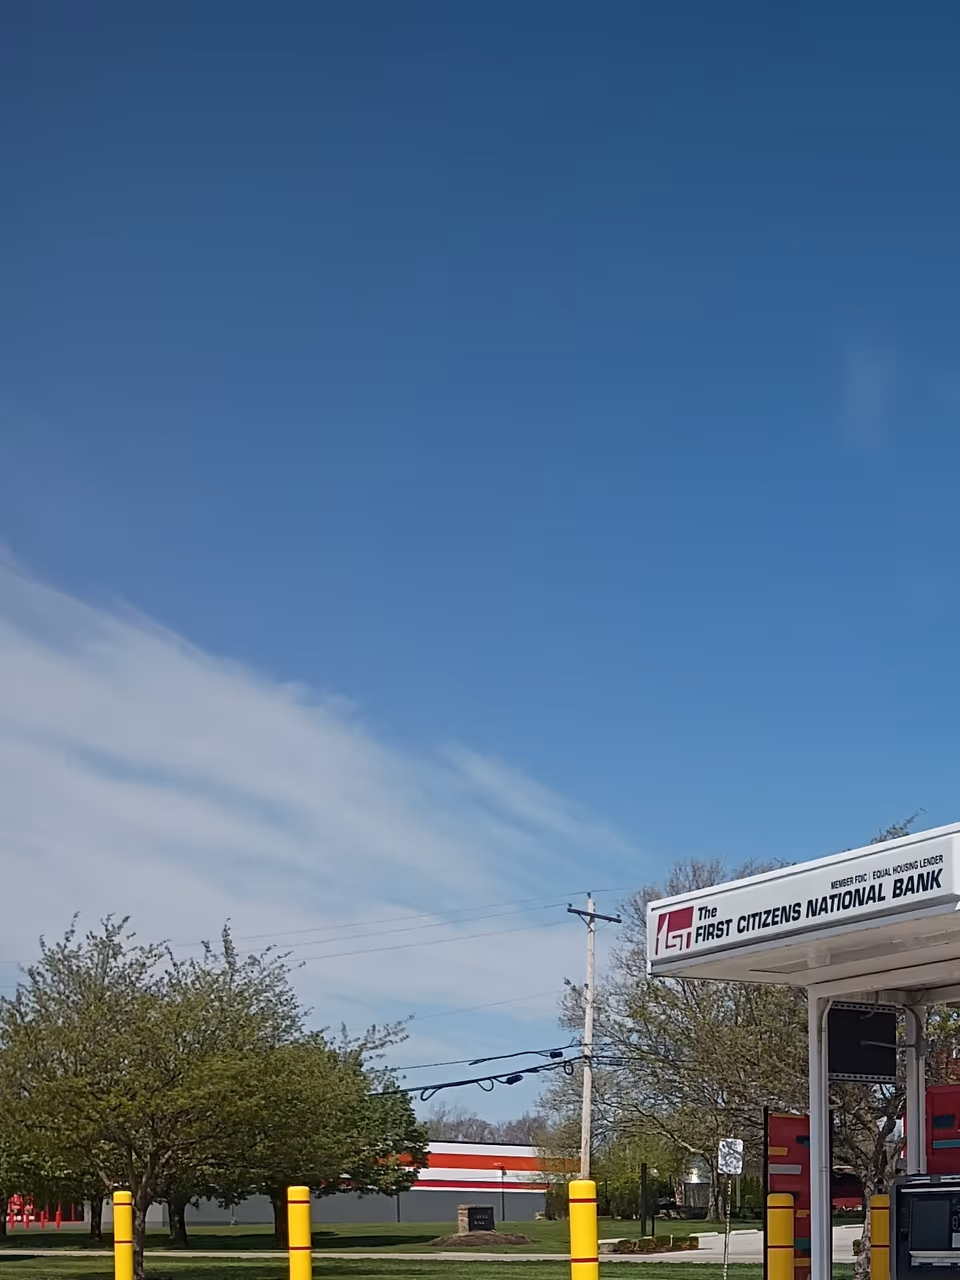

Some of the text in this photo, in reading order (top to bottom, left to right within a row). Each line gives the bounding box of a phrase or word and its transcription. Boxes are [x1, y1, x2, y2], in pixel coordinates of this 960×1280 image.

[831, 854, 944, 890] MEMBER FDIC EQUAL HOUSING LENDER
[695, 867, 944, 944] FIRST CITIZENS NATIONAL BANK
[698, 905, 717, 921] The
